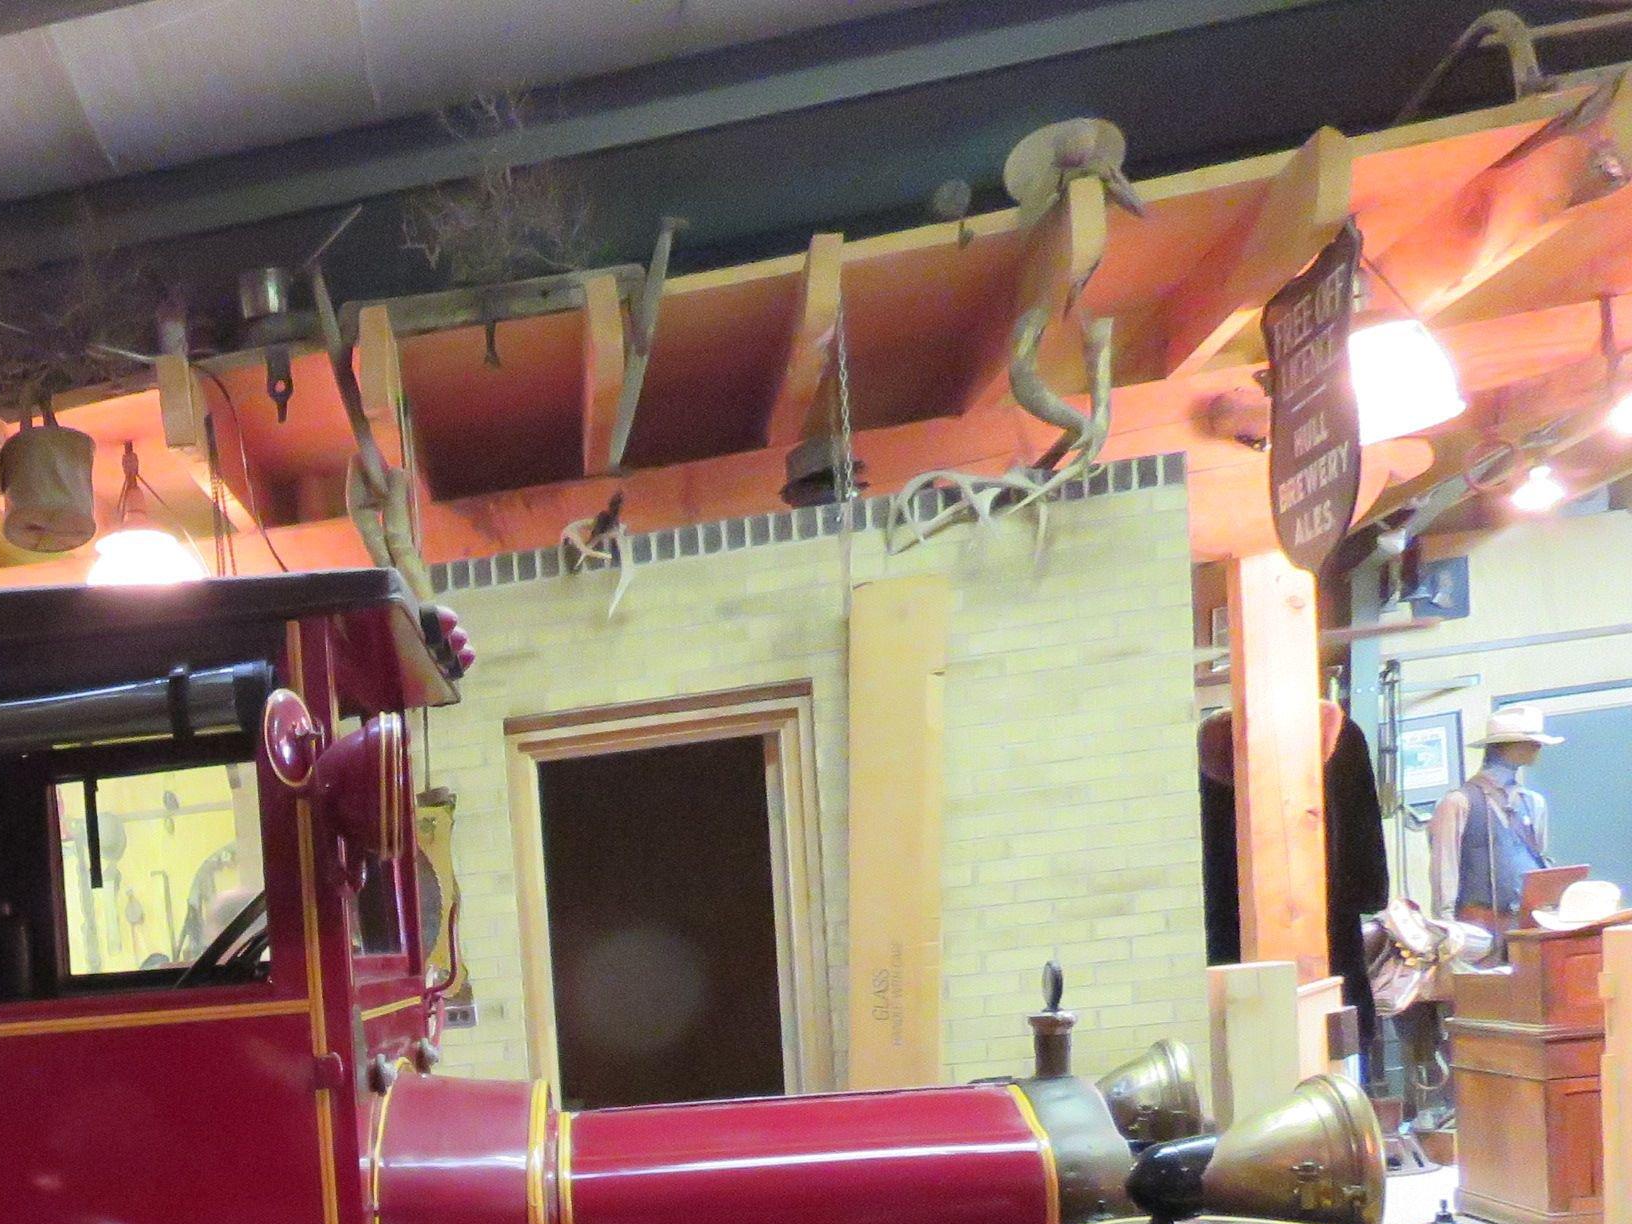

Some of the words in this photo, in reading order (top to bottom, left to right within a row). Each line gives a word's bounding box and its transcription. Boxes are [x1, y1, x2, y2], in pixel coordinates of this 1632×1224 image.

[1278, 440, 1349, 514] BREWERY
[1294, 499, 1335, 546] ALES
[871, 968, 890, 1021] GLASS
